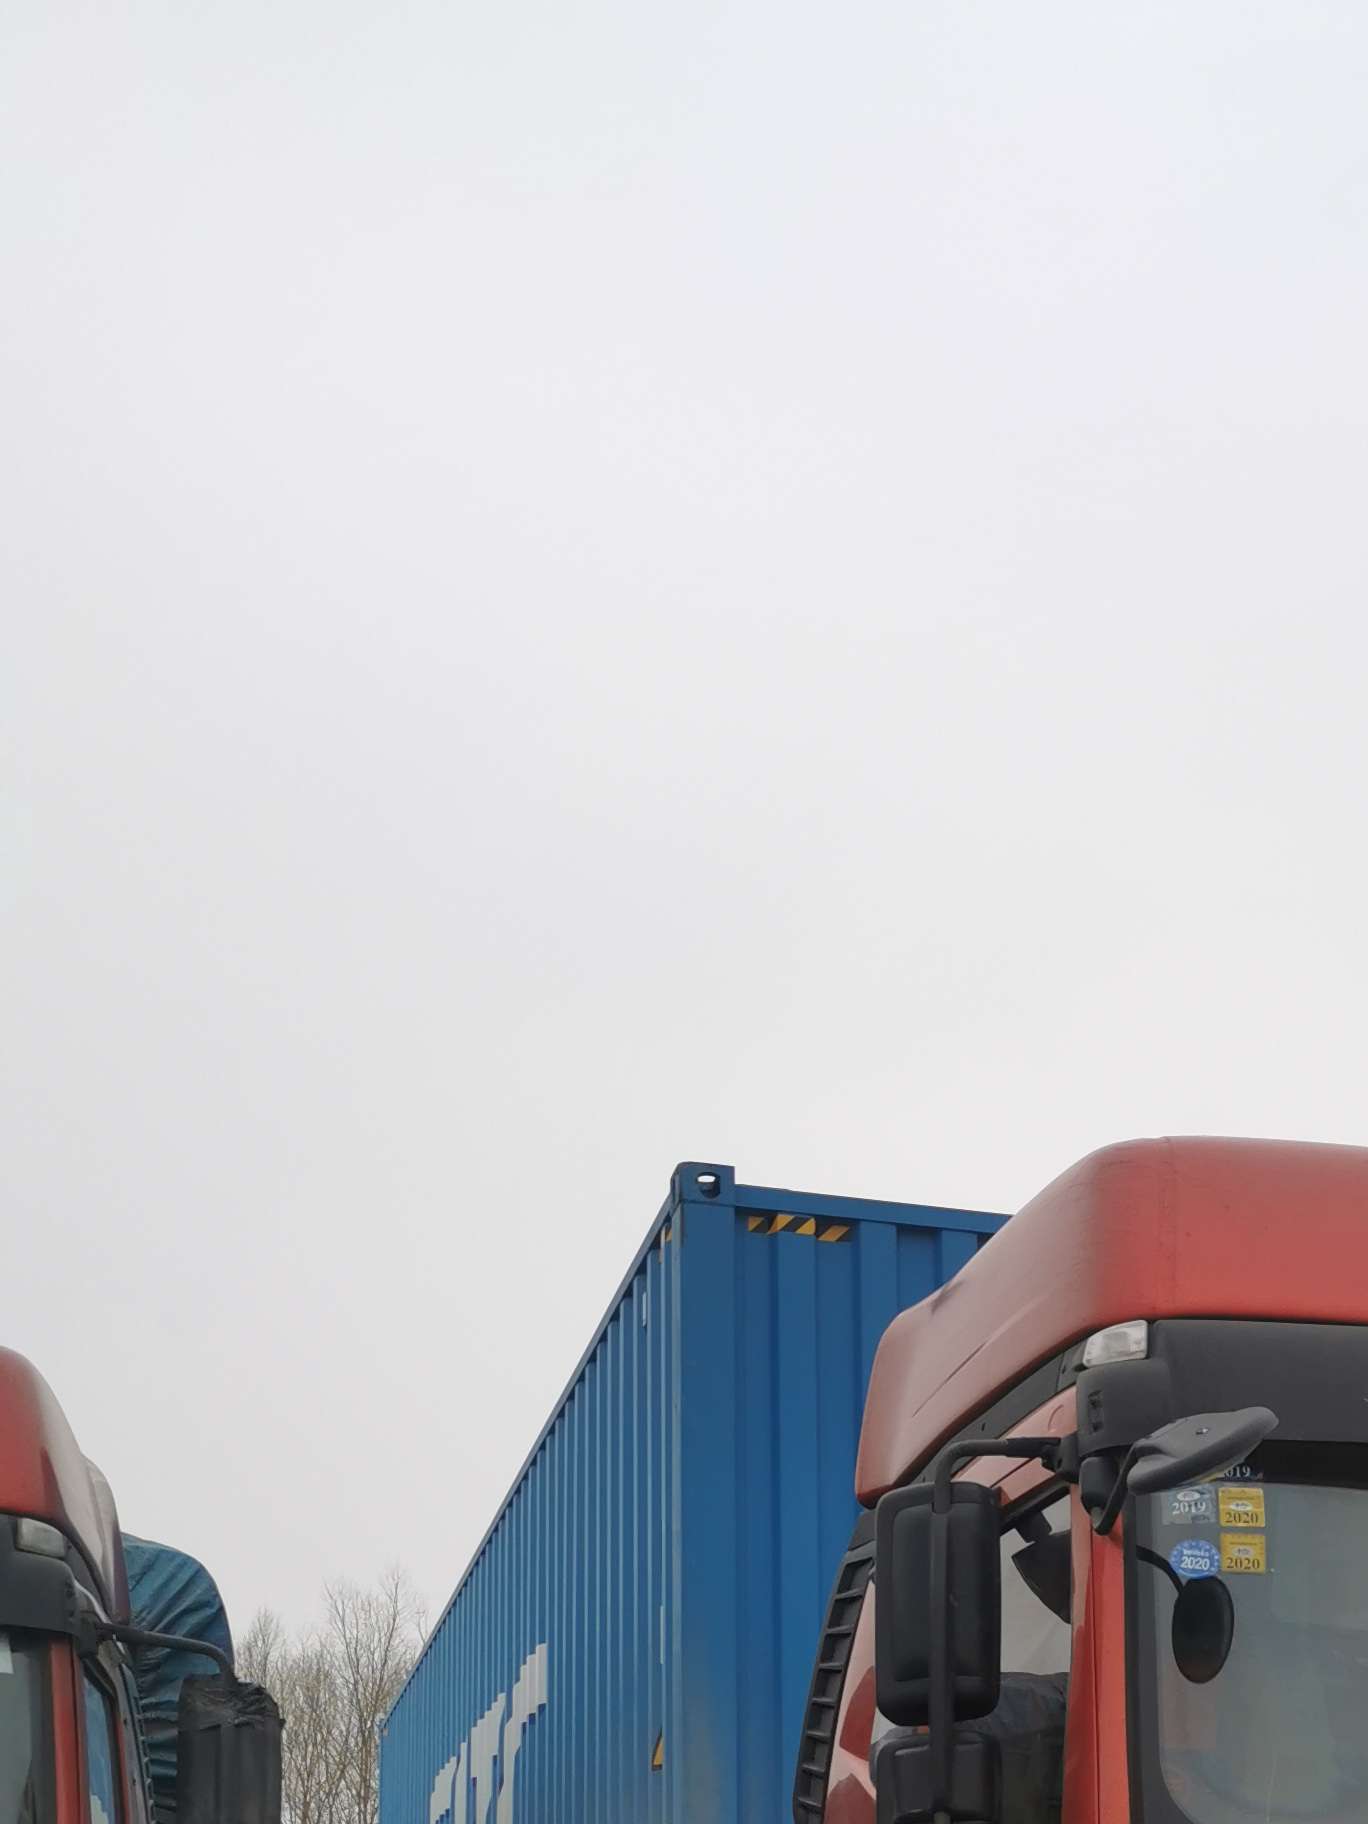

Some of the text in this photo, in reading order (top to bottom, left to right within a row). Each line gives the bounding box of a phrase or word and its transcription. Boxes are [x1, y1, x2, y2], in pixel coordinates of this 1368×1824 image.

[1171, 1501, 1207, 1514] 2019
[1225, 1511, 1259, 1524] 2020
[1180, 1556, 1210, 1571] 2020
[1226, 1557, 1260, 1570] 2020
